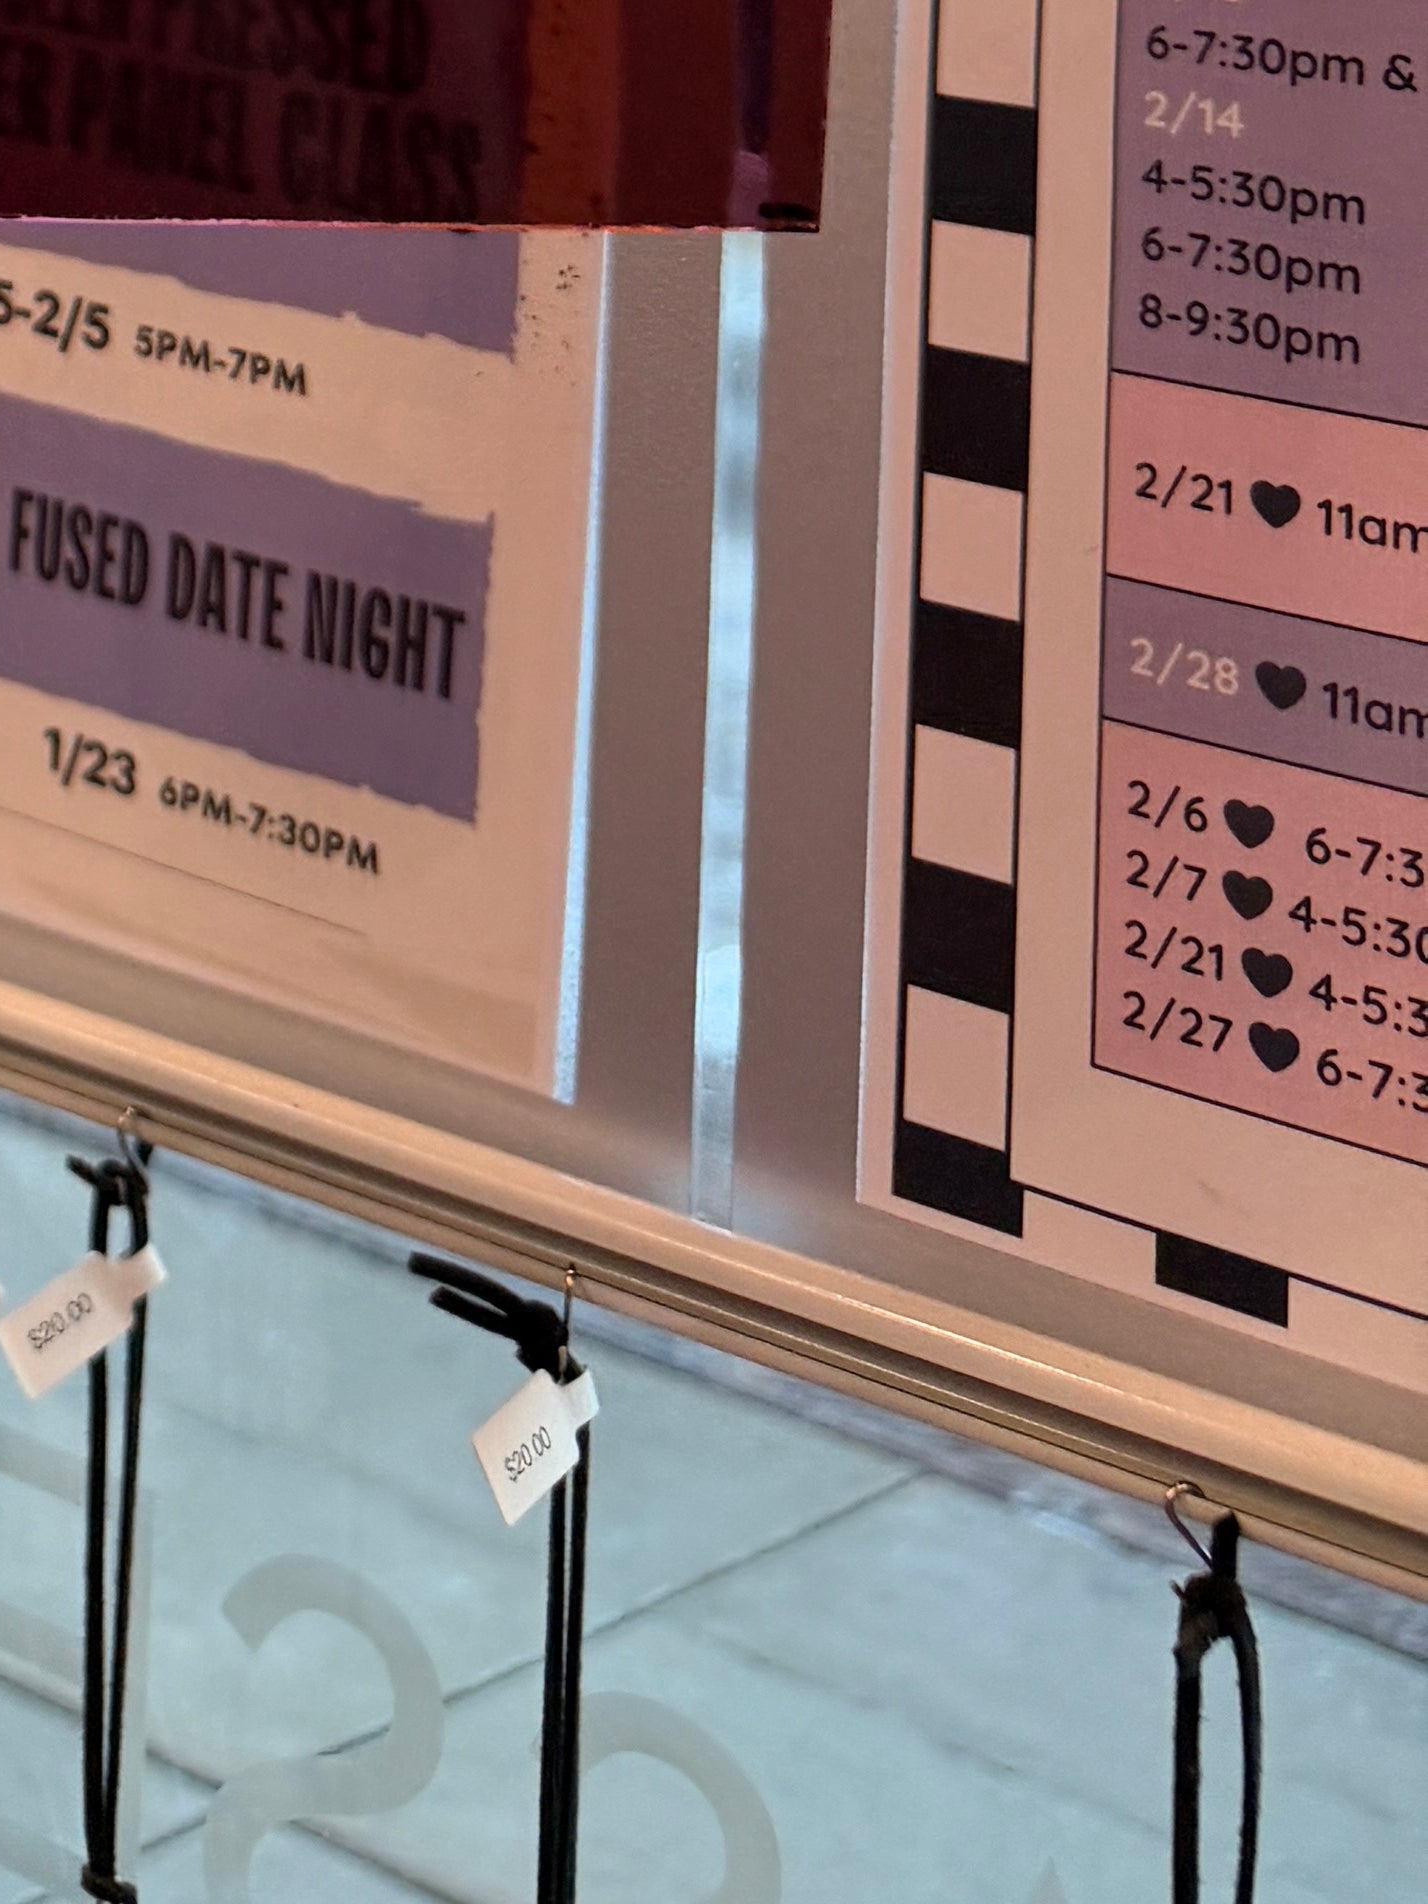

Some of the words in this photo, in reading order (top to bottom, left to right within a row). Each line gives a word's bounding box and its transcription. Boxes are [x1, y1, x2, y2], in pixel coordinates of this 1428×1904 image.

[1146, 25, 1365, 87] 6-7:30pm
[1382, 53, 1418, 92] &
[66, 49, 256, 196] PANEL
[276, 88, 485, 221] CLASS
[1144, 90, 1245, 139] 2/14
[1141, 158, 1366, 225] 4-5:30pm
[1140, 225, 1361, 294] 6-7:30pm
[134, 323, 308, 397] 5PM-7PM
[1138, 292, 1361, 365] 8-9:30pm
[1134, 461, 1234, 516] 2/21
[7, 486, 151, 608] FUSED
[164, 530, 290, 653] DATE
[300, 568, 467, 700] NIGHT
[1129, 637, 1240, 697] 2/28
[43, 726, 138, 797] 1/23
[157, 775, 382, 876] 6PM-7:30PM
[1127, 779, 1209, 833] 2/6
[1126, 848, 1208, 901] 2/7
[1124, 919, 1224, 982] 2/21
[1122, 990, 1234, 1053] 2/27
